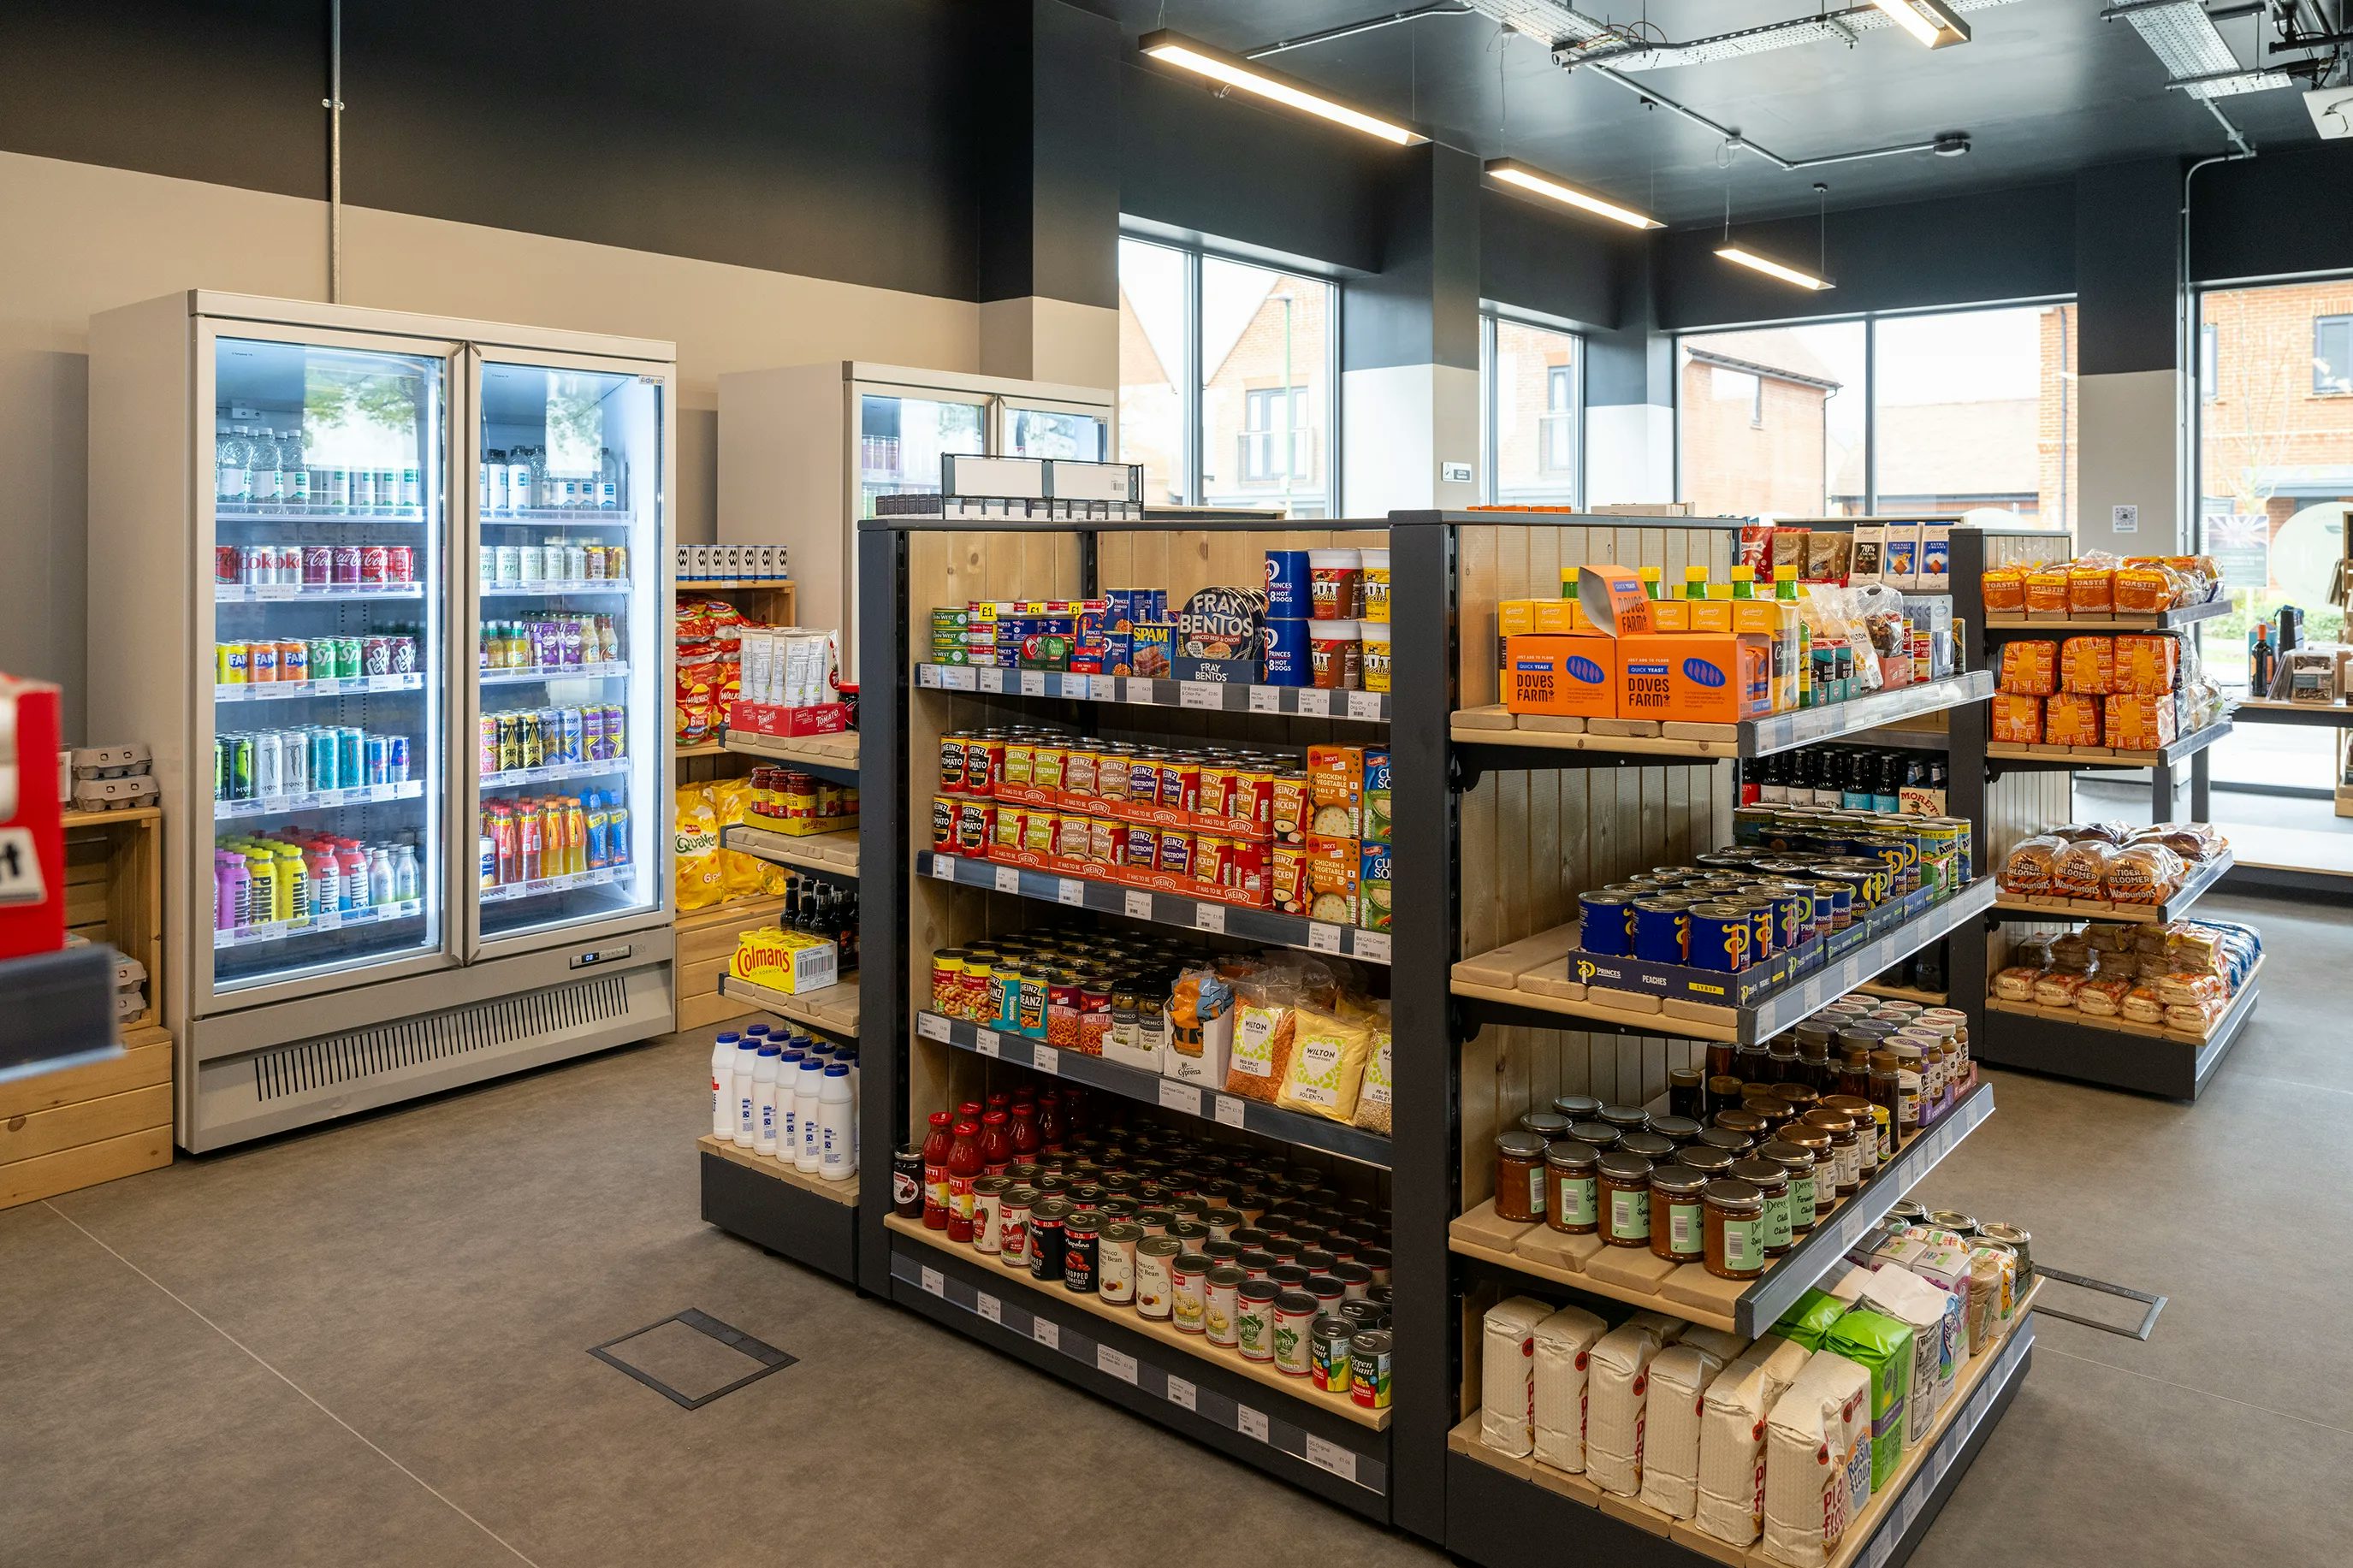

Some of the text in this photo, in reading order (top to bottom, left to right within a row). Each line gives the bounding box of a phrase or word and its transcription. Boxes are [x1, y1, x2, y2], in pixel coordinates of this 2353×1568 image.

[1861, 544, 1876, 553] 70%
[1270, 591, 1276, 602] 8
[1194, 593, 1240, 614] FRAY
[1986, 604, 2024, 612] Warburtons
[2028, 604, 2067, 614] Warburtons
[2072, 602, 2112, 612] Warburtons
[2116, 603, 2156, 613] Warburtons
[982, 607, 993, 617] £1
[1071, 606, 1080, 615] £1
[1180, 613, 1254, 637] BENTOS
[1622, 616, 1645, 632] FARM
[1133, 627, 1169, 642] SPAM
[1200, 663, 1222, 672] FRAY
[1269, 660, 1275, 672] 8
[1195, 672, 1228, 682] BENTOS
[1518, 689, 1548, 702] FARM
[1629, 693, 1663, 707] FARM
[815, 710, 839, 727] TOMATO
[942, 743, 960, 752] HEINZ
[1070, 756, 1090, 766] HEINZ
[1102, 761, 1123, 771] HEINZ
[1132, 767, 1153, 777] HEINZ
[1316, 778, 1347, 788] VEGETABLE
[1027, 790, 1045, 801] HEINZ
[1275, 785, 1295, 796] HEINZ
[1090, 802, 1110, 814] HEINZ
[1155, 813, 1175, 823] HEINZ
[1063, 822, 1083, 831] HEINZ
[1230, 821, 1252, 833] HEINZ
[1130, 831, 1151, 841] HEINZ
[1164, 837, 1182, 847] HEINZ
[1314, 859, 1340, 868] CHICKEN
[2017, 861, 2041, 873] TIGER
[2067, 861, 2091, 872] TIGER
[1314, 866, 1345, 876] VEGETABLE
[2009, 867, 2048, 877] BLOOMER
[2059, 867, 2097, 879] BLOOMER
[1154, 878, 1175, 889] HEINZ
[2007, 879, 2051, 890] Warburtons
[2109, 875, 2150, 884] BLOOMER
[2055, 879, 2100, 894] Warburtons
[1227, 891, 1249, 902] HEINZ
[2109, 887, 2156, 898] Warburtons
[737, 945, 791, 978] Colman's
[1596, 967, 1621, 977] PRINCES
[1642, 975, 1667, 986] PEACHES
[1245, 1020, 1267, 1032] WILTON
[1307, 1047, 1336, 1059] WILTON
[1177, 1068, 1201, 1078] Cypressa
[1299, 1092, 1325, 1102] POLENTA
[1372, 1093, 1391, 1102] BARLEY
[1065, 1238, 1090, 1249] Napolina
[1065, 1269, 1088, 1280] CHOPPED
[1066, 1276, 1086, 1285] TOMATOES
[1313, 1340, 1325, 1352] reen
[1313, 1348, 1328, 1358] iant
[1351, 1355, 1372, 1369] Green
[1352, 1364, 1375, 1376] Giant
